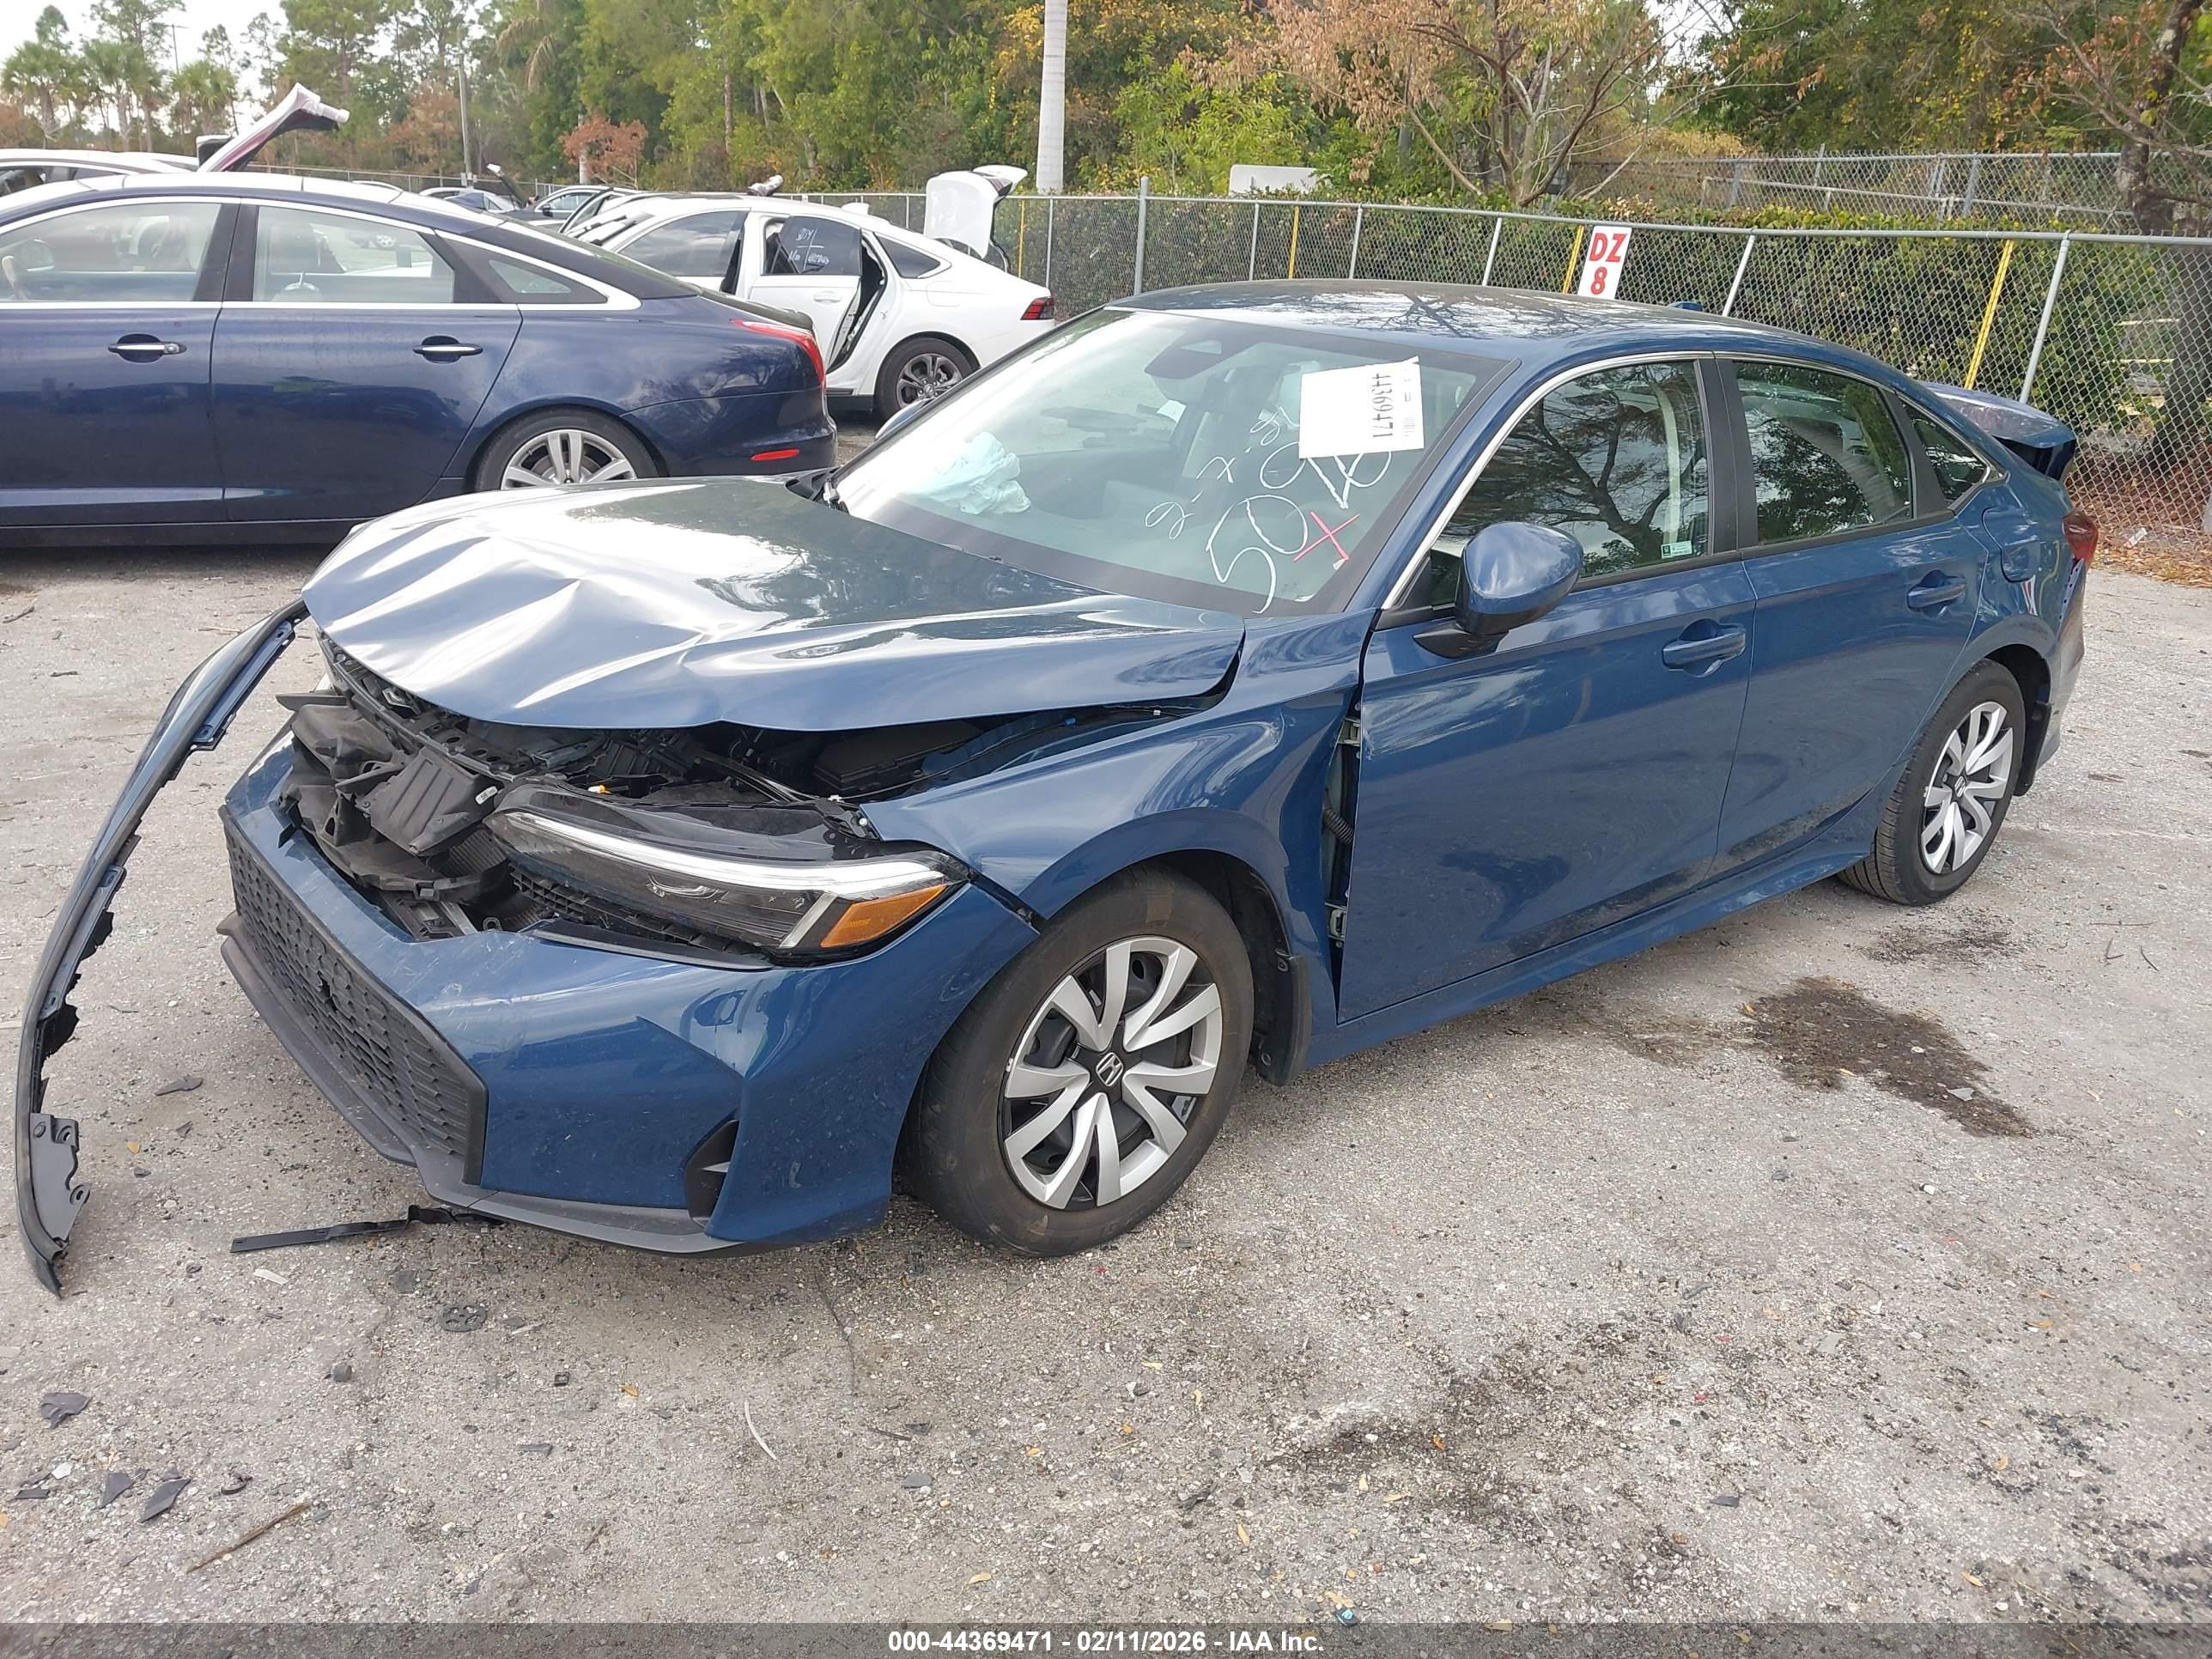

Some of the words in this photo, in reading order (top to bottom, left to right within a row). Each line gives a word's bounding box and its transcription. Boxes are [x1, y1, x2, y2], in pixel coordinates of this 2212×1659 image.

[1589, 232, 1628, 263] DZ
[1590, 266, 1608, 295] 8
[1372, 373, 1394, 438] 44369471
